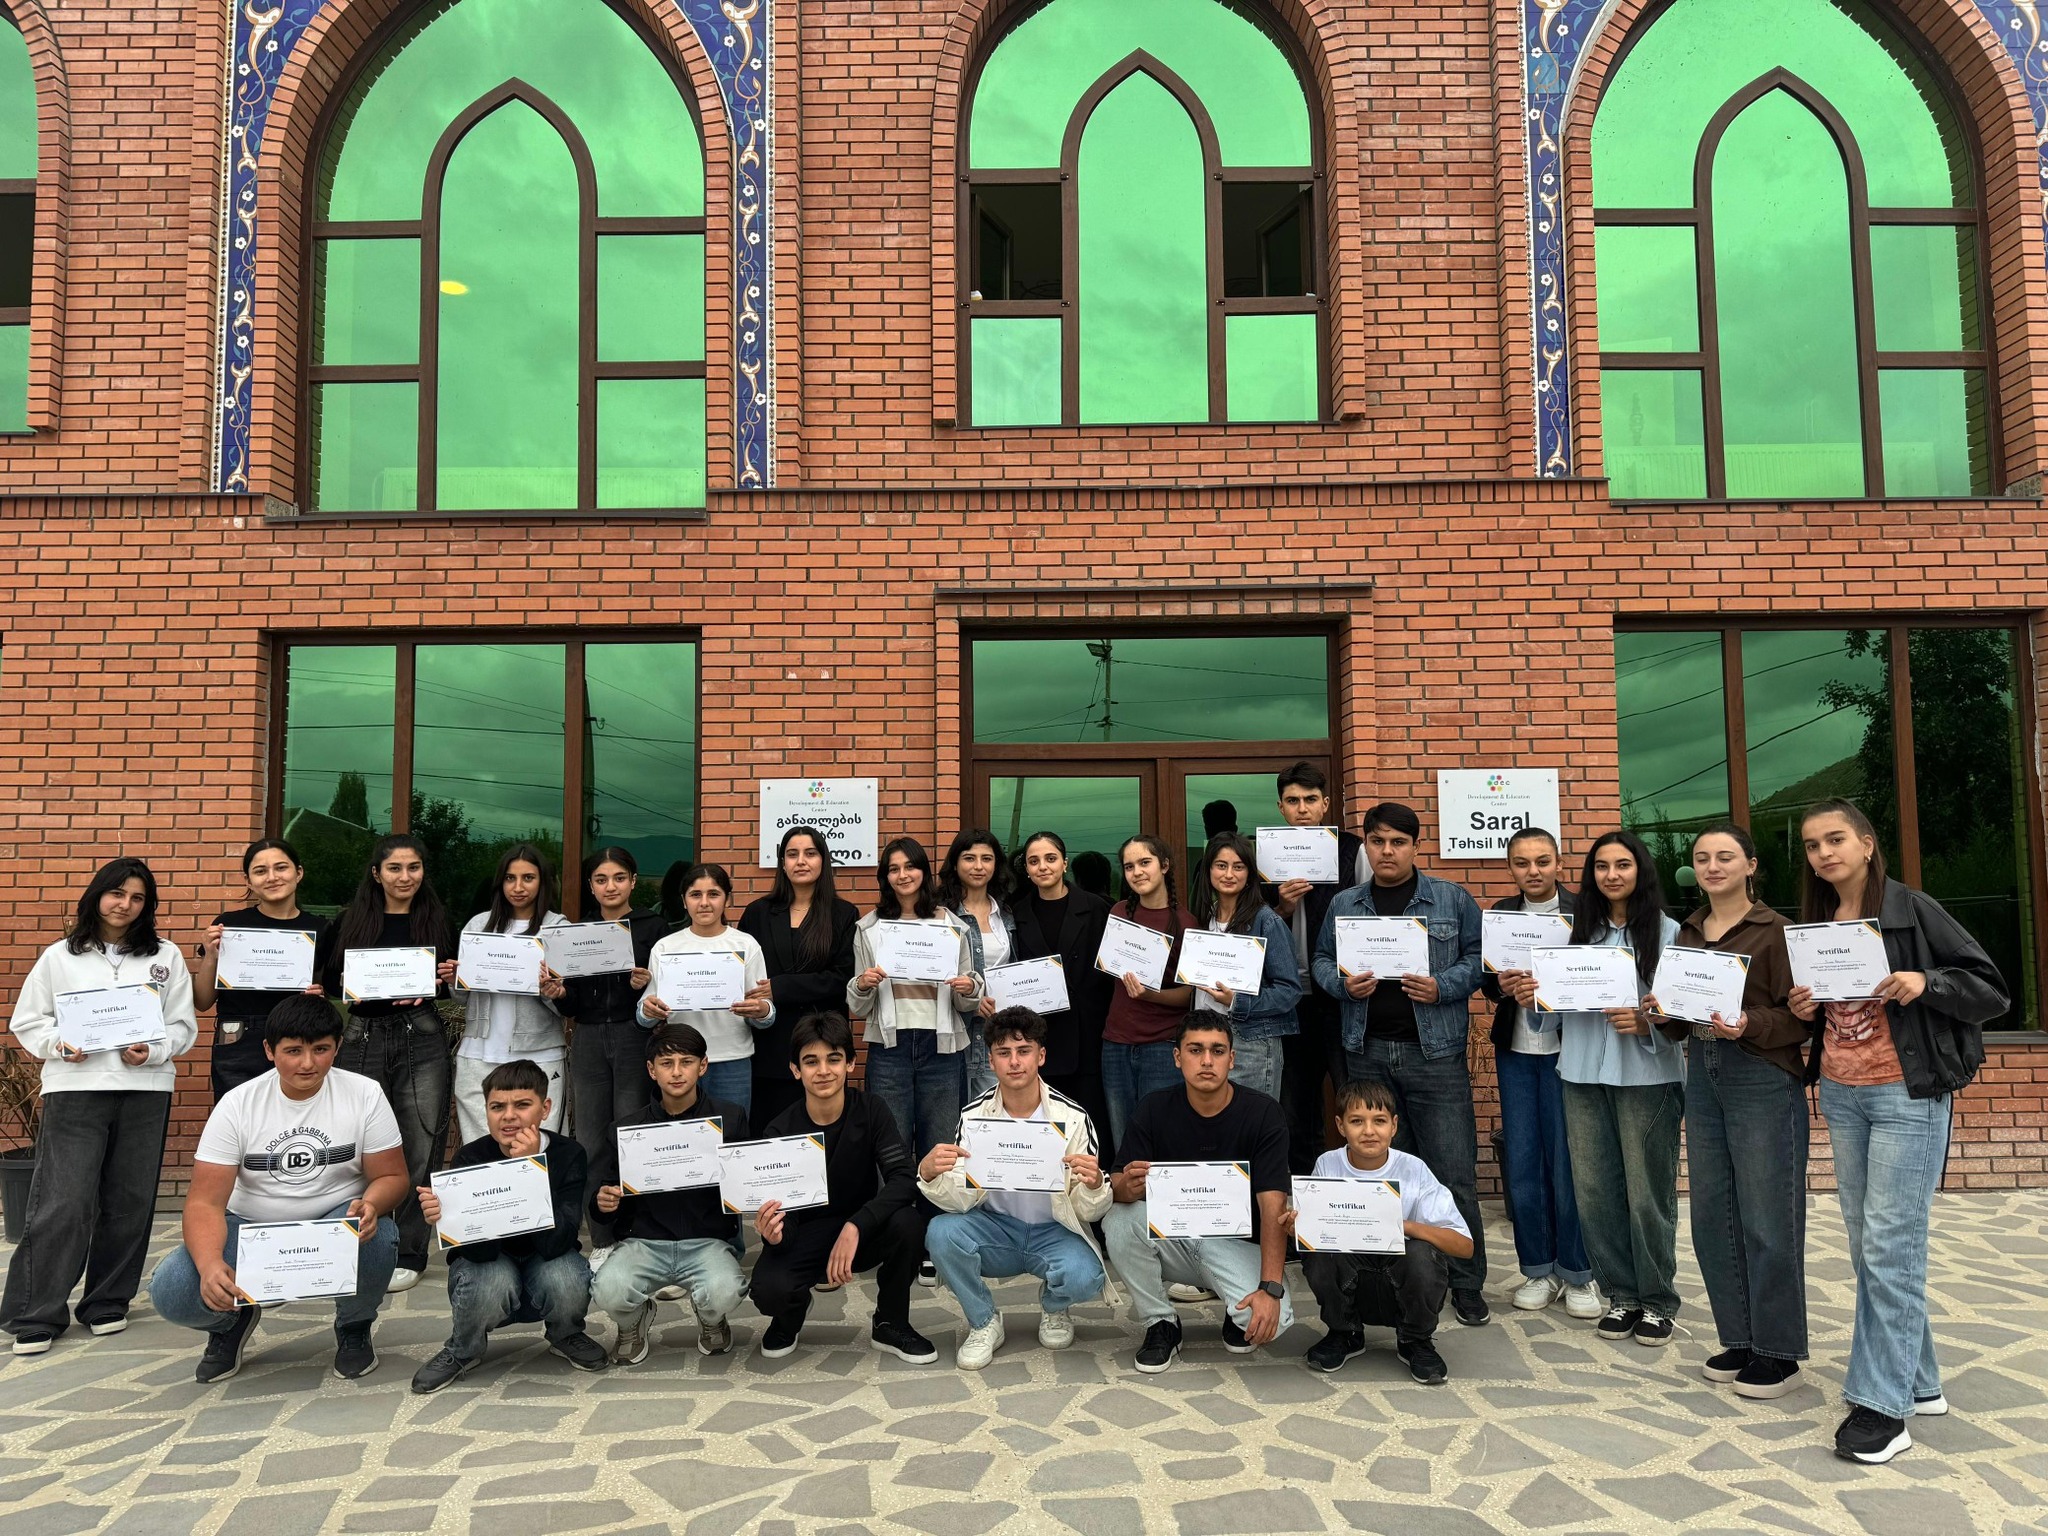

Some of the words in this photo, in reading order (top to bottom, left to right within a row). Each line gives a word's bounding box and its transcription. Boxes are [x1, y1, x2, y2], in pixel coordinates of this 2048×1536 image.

[776, 813, 862, 828] განათლების
[1470, 811, 1530, 830] Saral
[1449, 837, 1492, 849] Təhsil
[1816, 947, 1851, 956] Sertifikat
[91, 1005, 128, 1015] Sertifikat
[265, 1130, 290, 1152] DOLCE
[298, 1126, 332, 1146] GABBANA
[653, 1143, 690, 1153] Sertifikat
[997, 1142, 1033, 1150] Sertifikat
[287, 1152, 312, 1168] DG
[753, 1161, 791, 1172] Sertifikat
[472, 1186, 512, 1198] Sertifikat
[1180, 1186, 1216, 1194] Sertifikat
[1328, 1202, 1366, 1210] Sertifikat
[278, 1247, 320, 1255] Sertifikat
